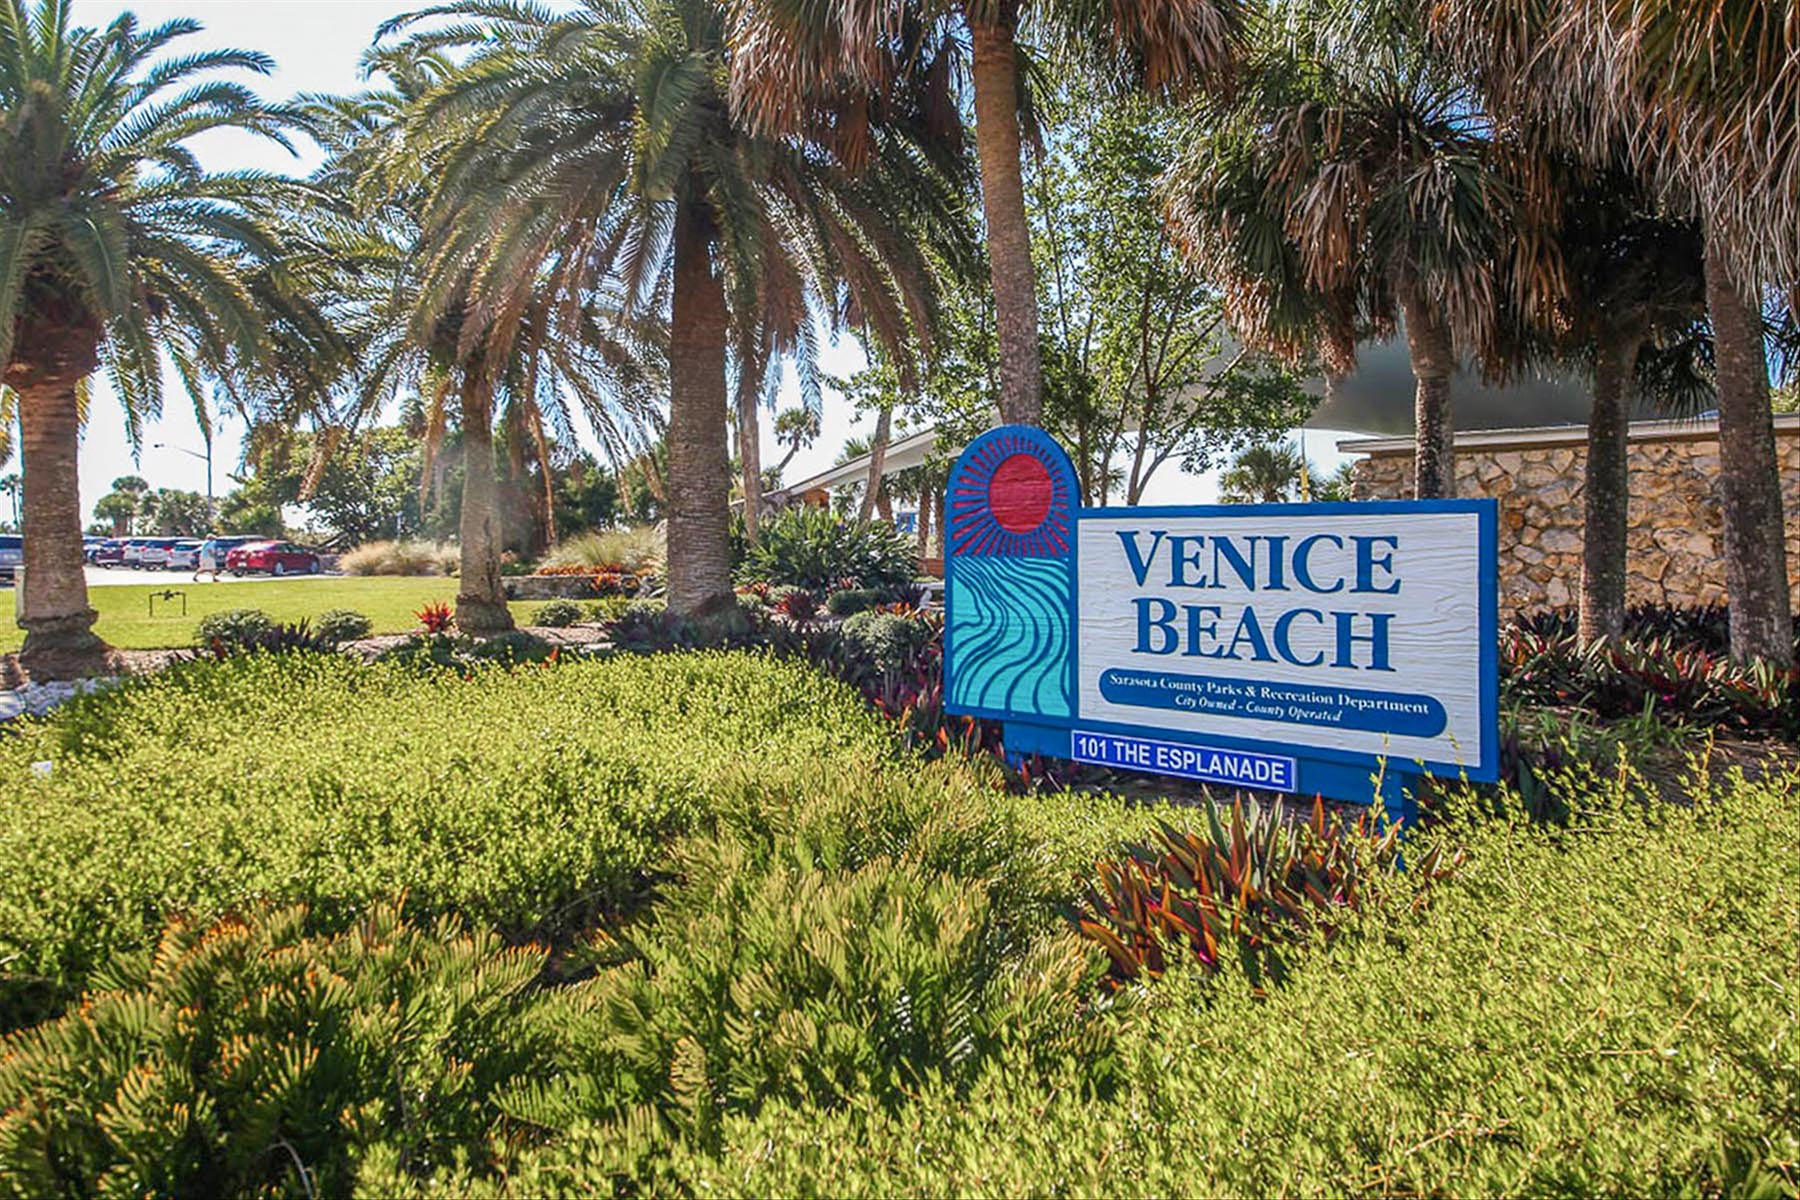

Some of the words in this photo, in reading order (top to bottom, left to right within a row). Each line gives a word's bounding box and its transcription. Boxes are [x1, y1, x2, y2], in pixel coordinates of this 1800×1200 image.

[1116, 530, 1401, 595] VENICE
[1132, 597, 1397, 672] BEACH
[1109, 674, 1158, 688] Sarasota
[1160, 679, 1203, 694] County
[1207, 682, 1244, 696] Parks
[1245, 684, 1257, 697] &
[1260, 687, 1333, 702] Recreation
[1338, 695, 1428, 714] Department
[1175, 695, 1197, 708] City
[1199, 696, 1237, 711] Owned
[1245, 701, 1285, 718] County
[1288, 706, 1343, 722] Operated
[1079, 738, 1107, 759] 101
[1113, 741, 1150, 763] THE
[1157, 748, 1285, 784] ESPLANADE
